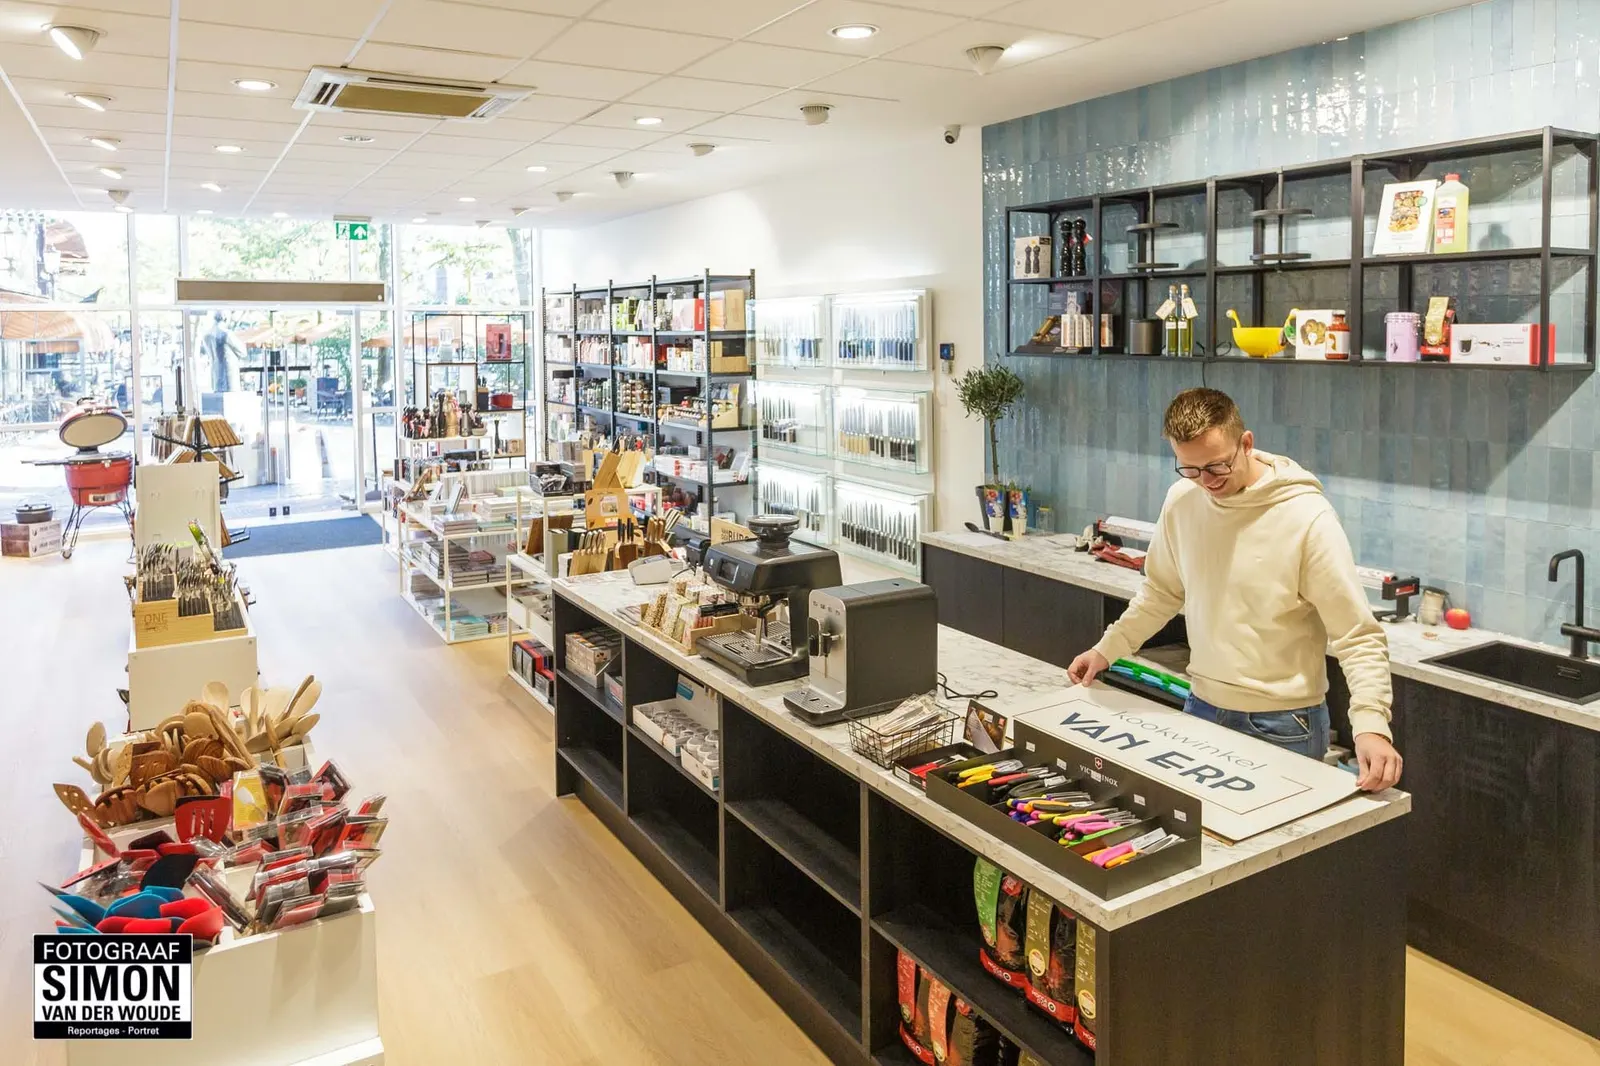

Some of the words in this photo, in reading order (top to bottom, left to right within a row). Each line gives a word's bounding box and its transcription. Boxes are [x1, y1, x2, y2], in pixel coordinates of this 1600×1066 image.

[1059, 711, 1149, 751] VAN
[1145, 750, 1257, 792] ERP
[1110, 710, 1269, 770] kookwinkel
[1079, 764, 1119, 787] VICINOX
